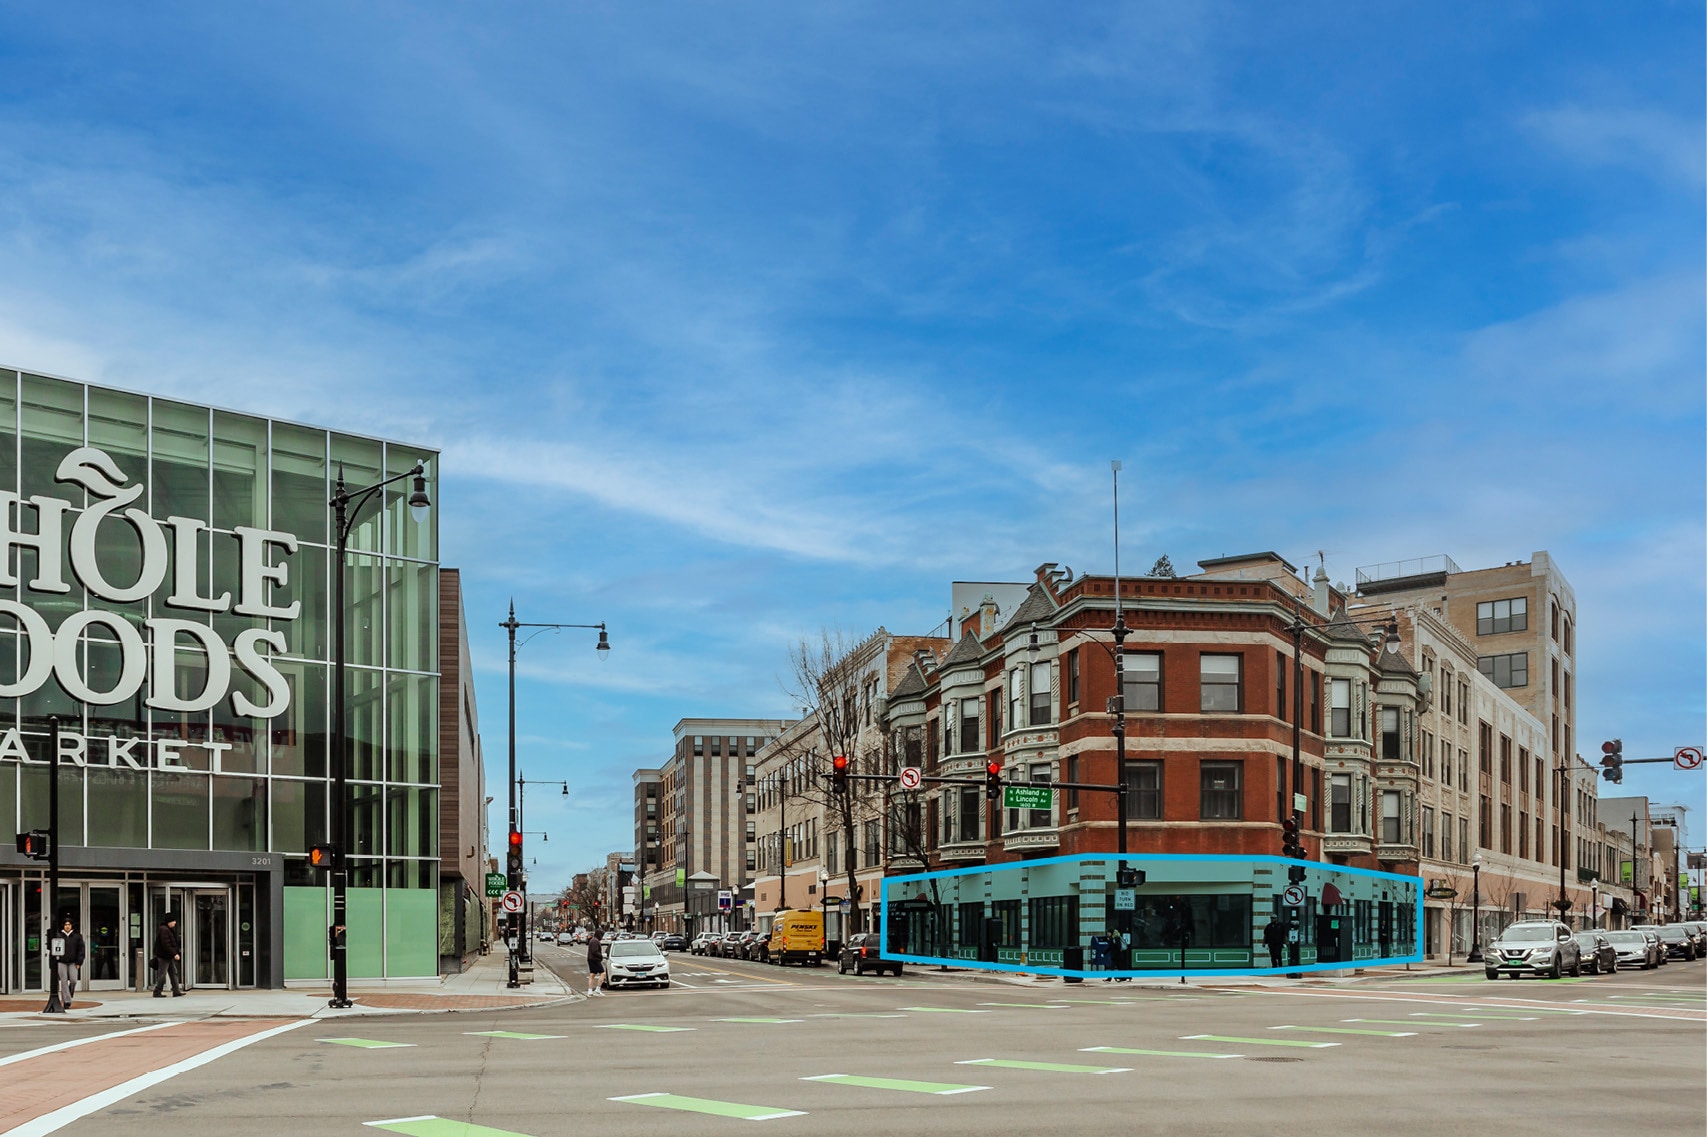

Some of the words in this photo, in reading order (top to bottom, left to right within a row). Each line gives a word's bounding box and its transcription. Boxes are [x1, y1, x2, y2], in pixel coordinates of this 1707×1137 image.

[0, 447, 300, 619] HOLE
[0, 600, 291, 719] OODS
[0, 728, 232, 774] ARKET
[1015, 788, 1040, 796] Ashland
[1015, 795, 1038, 803] Lincoln
[251, 857, 271, 865] 3201
